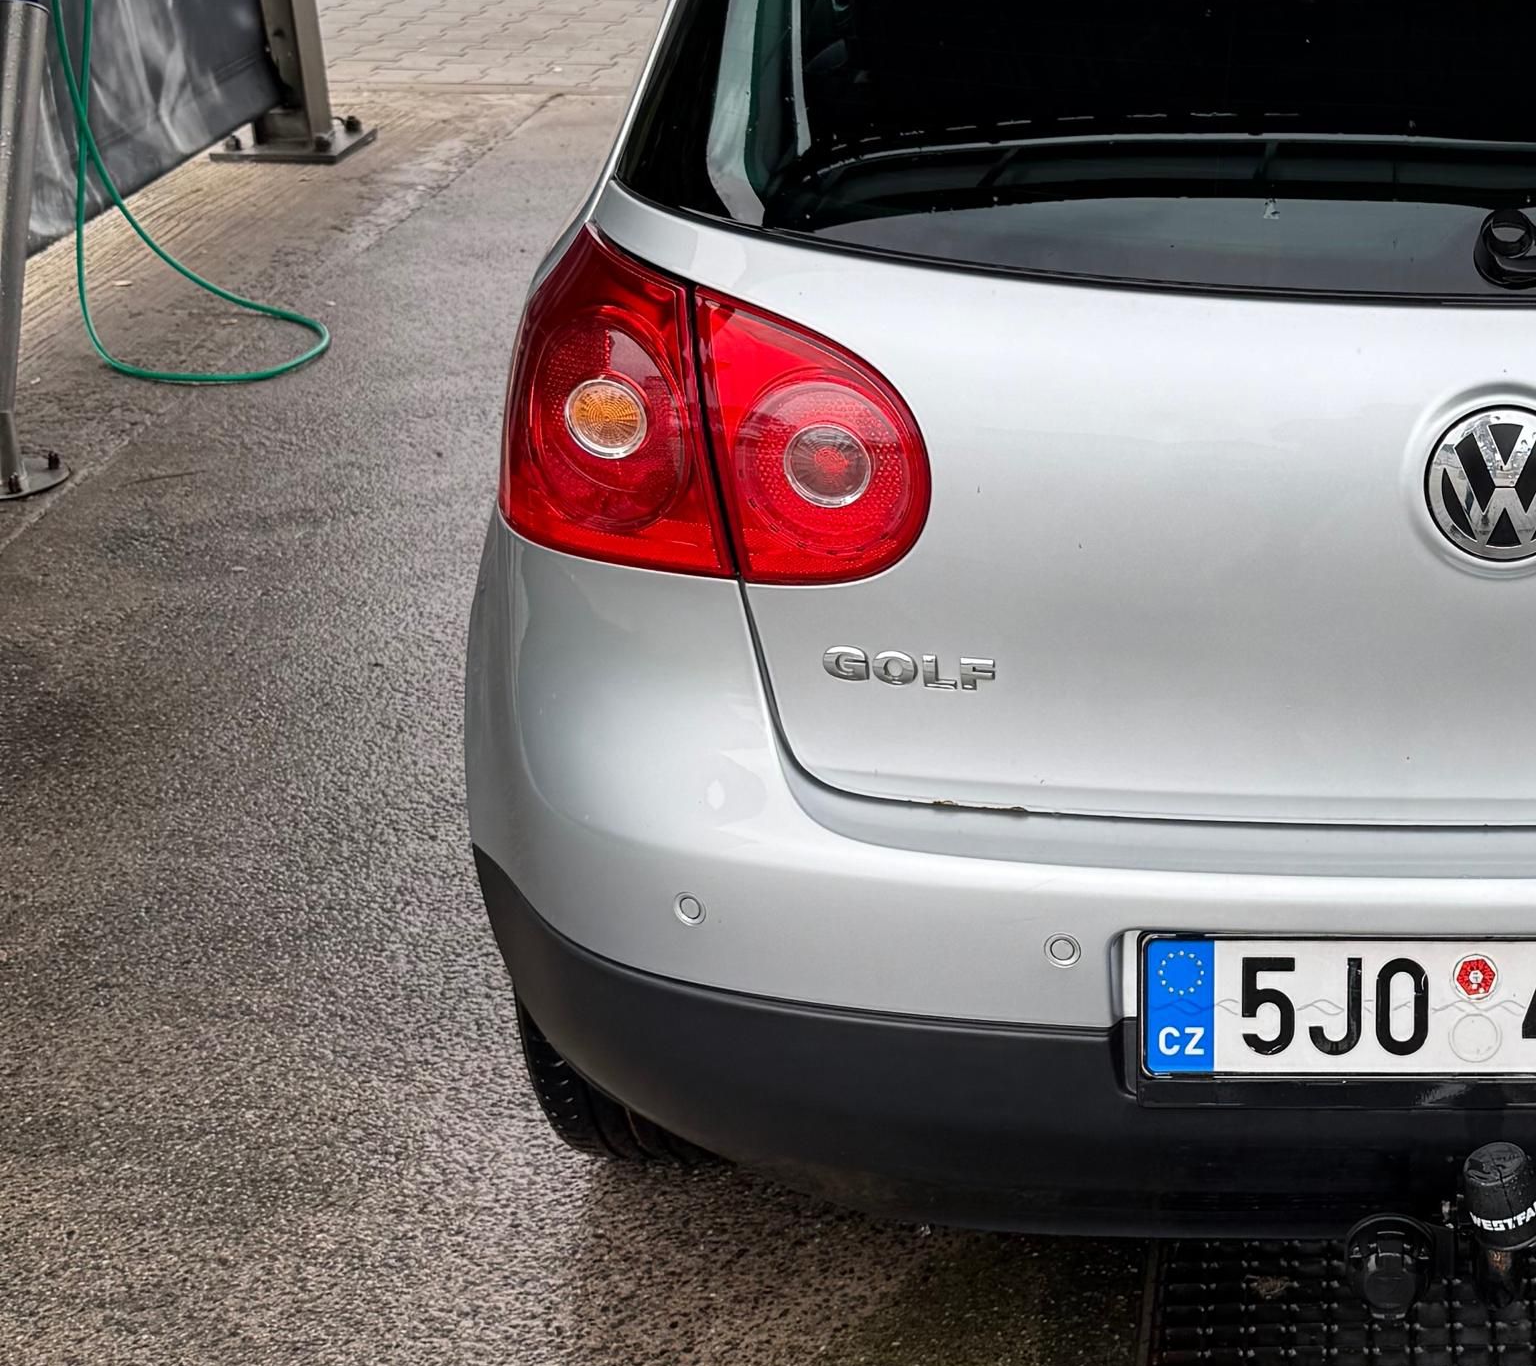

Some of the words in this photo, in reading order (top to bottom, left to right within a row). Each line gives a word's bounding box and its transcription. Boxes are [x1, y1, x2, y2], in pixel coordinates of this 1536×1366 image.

[822, 644, 996, 691] GOLF
[1241, 956, 1430, 1056] 5J0
[1157, 1026, 1205, 1056] CZ
